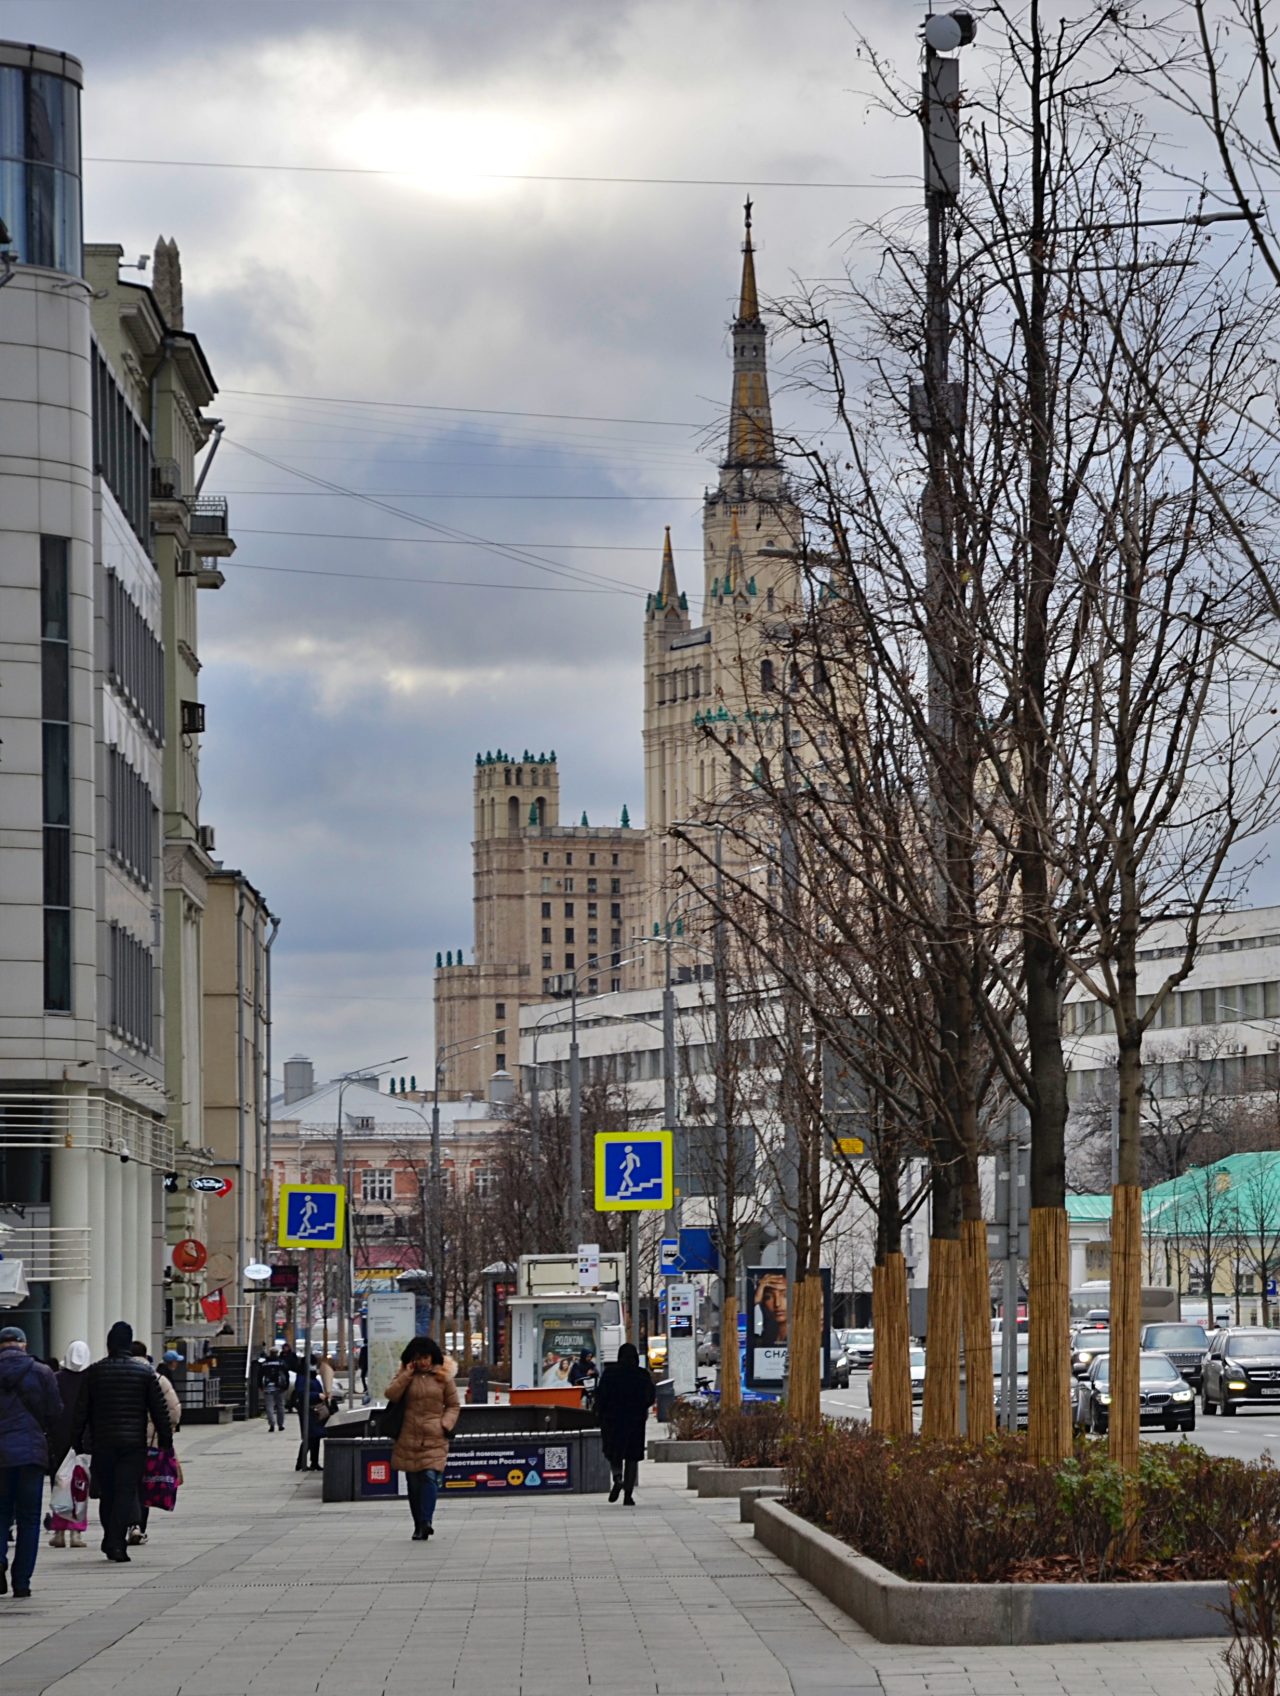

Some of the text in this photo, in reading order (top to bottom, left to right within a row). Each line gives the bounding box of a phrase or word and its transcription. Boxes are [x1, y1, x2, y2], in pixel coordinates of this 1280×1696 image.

[554, 1335, 584, 1345] РОДКОМ
[764, 1350, 788, 1359] CHA
[476, 1450, 514, 1458] помощник
